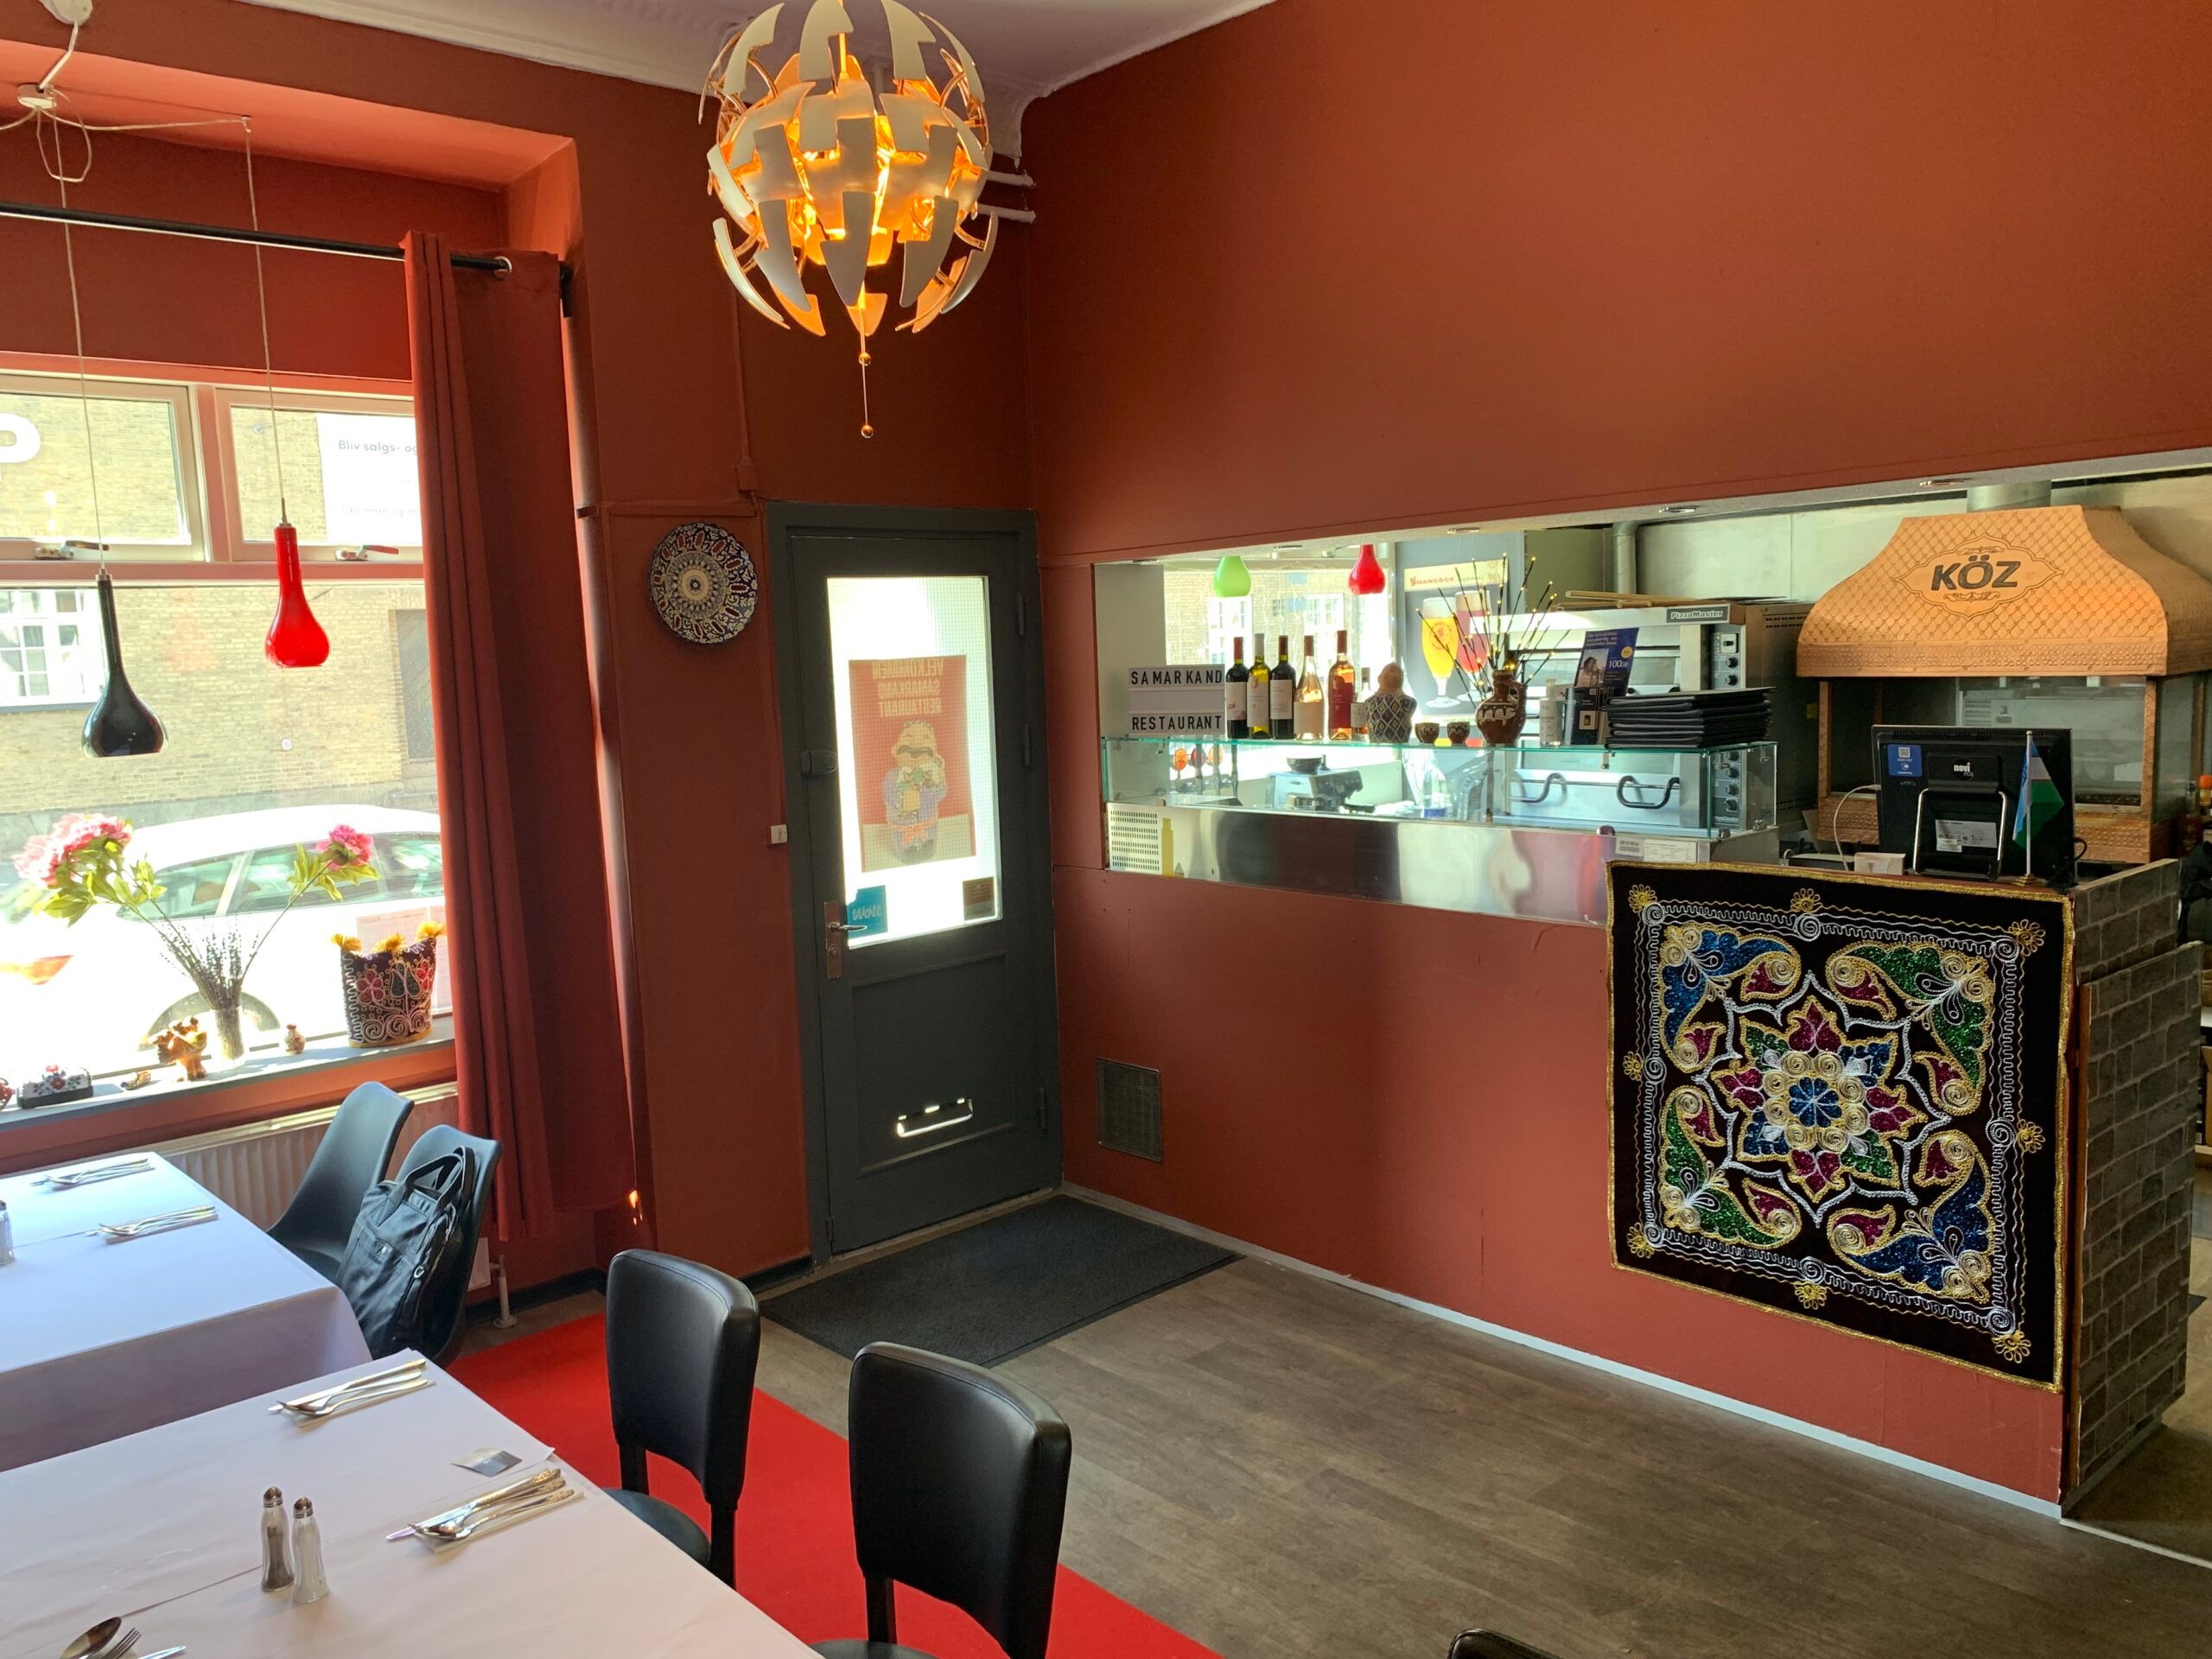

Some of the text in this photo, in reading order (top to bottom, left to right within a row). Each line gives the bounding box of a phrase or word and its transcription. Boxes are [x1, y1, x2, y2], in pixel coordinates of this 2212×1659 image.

[338, 440, 359, 450] Bliv
[363, 442, 401, 454] salgs-
[1930, 555, 2021, 591] KÖZ
[1670, 610, 1724, 620] PizzaMaster
[1131, 670, 1223, 684] SAMARKAND
[1132, 715, 1222, 730] RESTAURANT
[1953, 761, 1971, 772] novi
